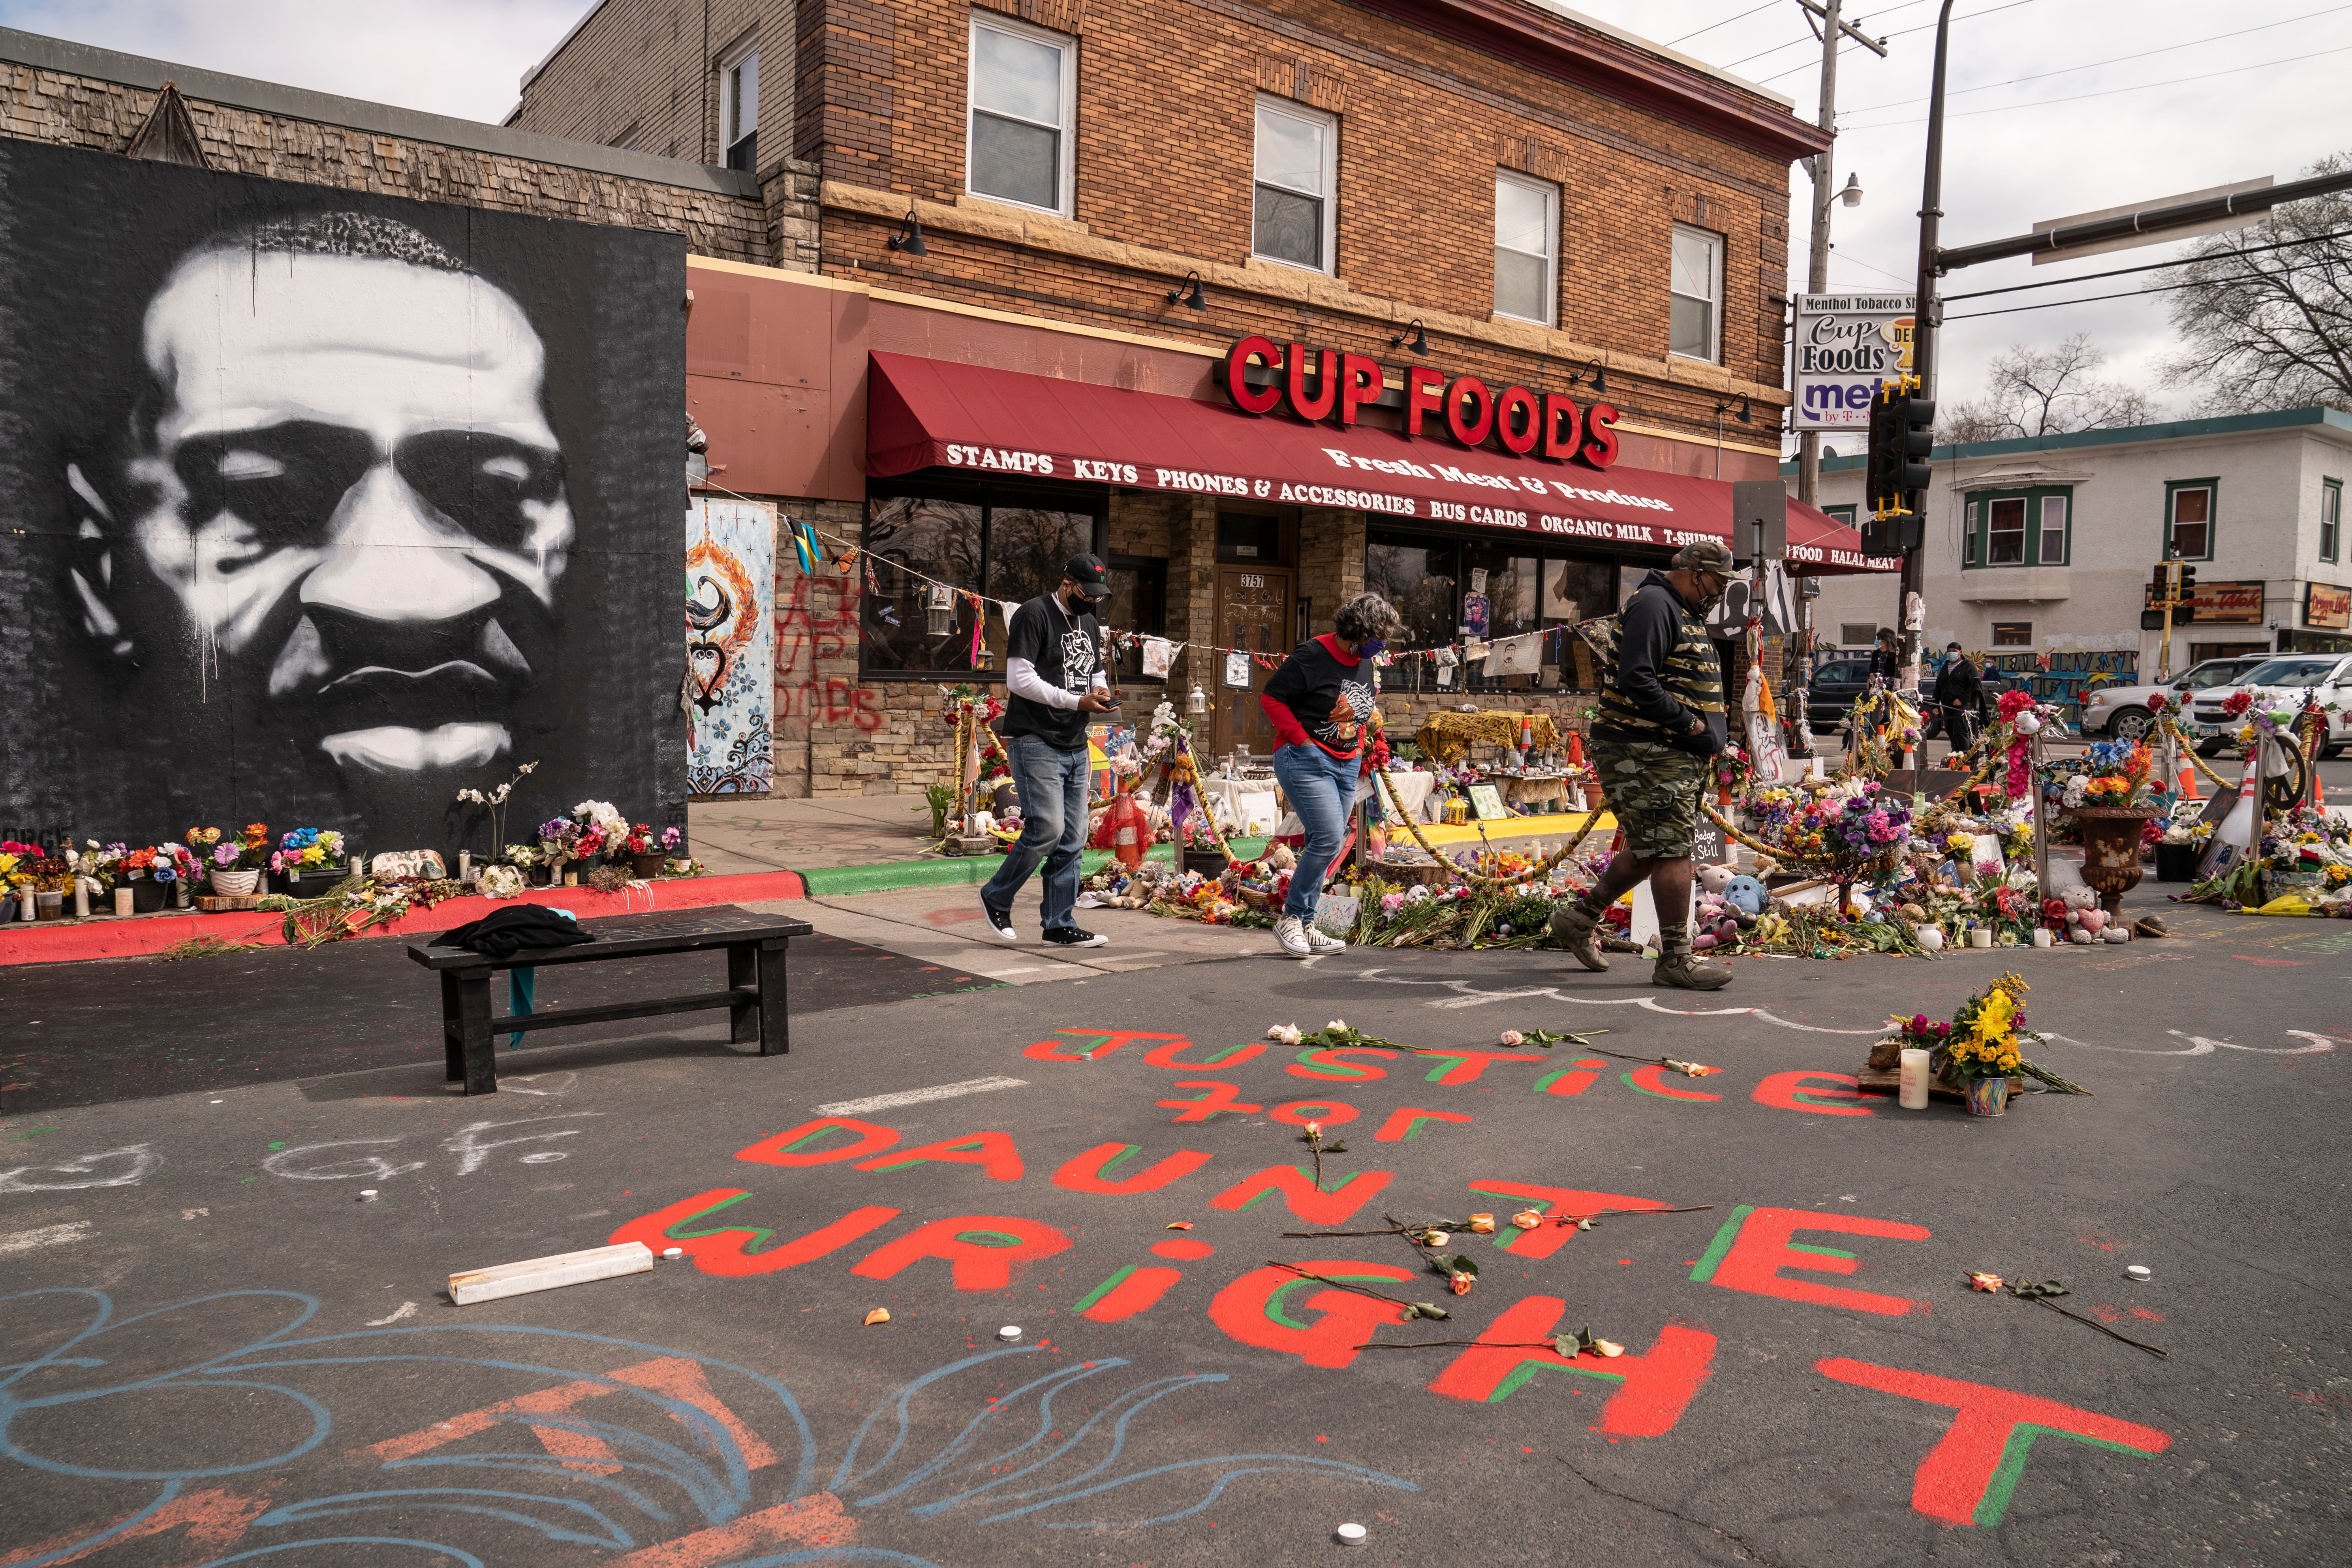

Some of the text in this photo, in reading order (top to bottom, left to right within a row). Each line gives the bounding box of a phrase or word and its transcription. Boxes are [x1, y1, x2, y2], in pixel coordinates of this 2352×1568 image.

[1806, 297, 1917, 310] Menthol Tobacco Sh
[1810, 315, 1878, 350] Cup
[1802, 345, 1884, 370] Foods
[1223, 335, 1620, 468] CUP FOODS
[1806, 377, 1883, 409] met
[1825, 411, 1839, 425] by
[1321, 447, 1674, 513] Fresh Meat & Produce
[946, 443, 1054, 475] STAMPS
[1074, 459, 1138, 484] KEYS
[1156, 468, 1249, 496] PHONES
[1254, 480, 1272, 498] &
[1279, 483, 1416, 515] ACCESSORIES
[1430, 501, 1466, 521] BUS
[1469, 505, 1528, 528] CARDS
[1540, 515, 1613, 538] ORGANIC
[1616, 522, 1653, 542] MILK
[1792, 546, 1823, 561] FOOD
[1831, 550, 1865, 567] HALAL
[1242, 575, 1263, 587] 3757
[2218, 588, 2261, 610] Wok
[2, 828, 72, 849] ORGE
[1694, 828, 1716, 845] Badge
[376, 850, 429, 863] GEORGE
[1697, 844, 1718, 860] Still
[2083, 913, 2103, 924] Love
[733, 1117, 1933, 1317] DAUNTE
[549, 1269, 594, 1283] POTTER
